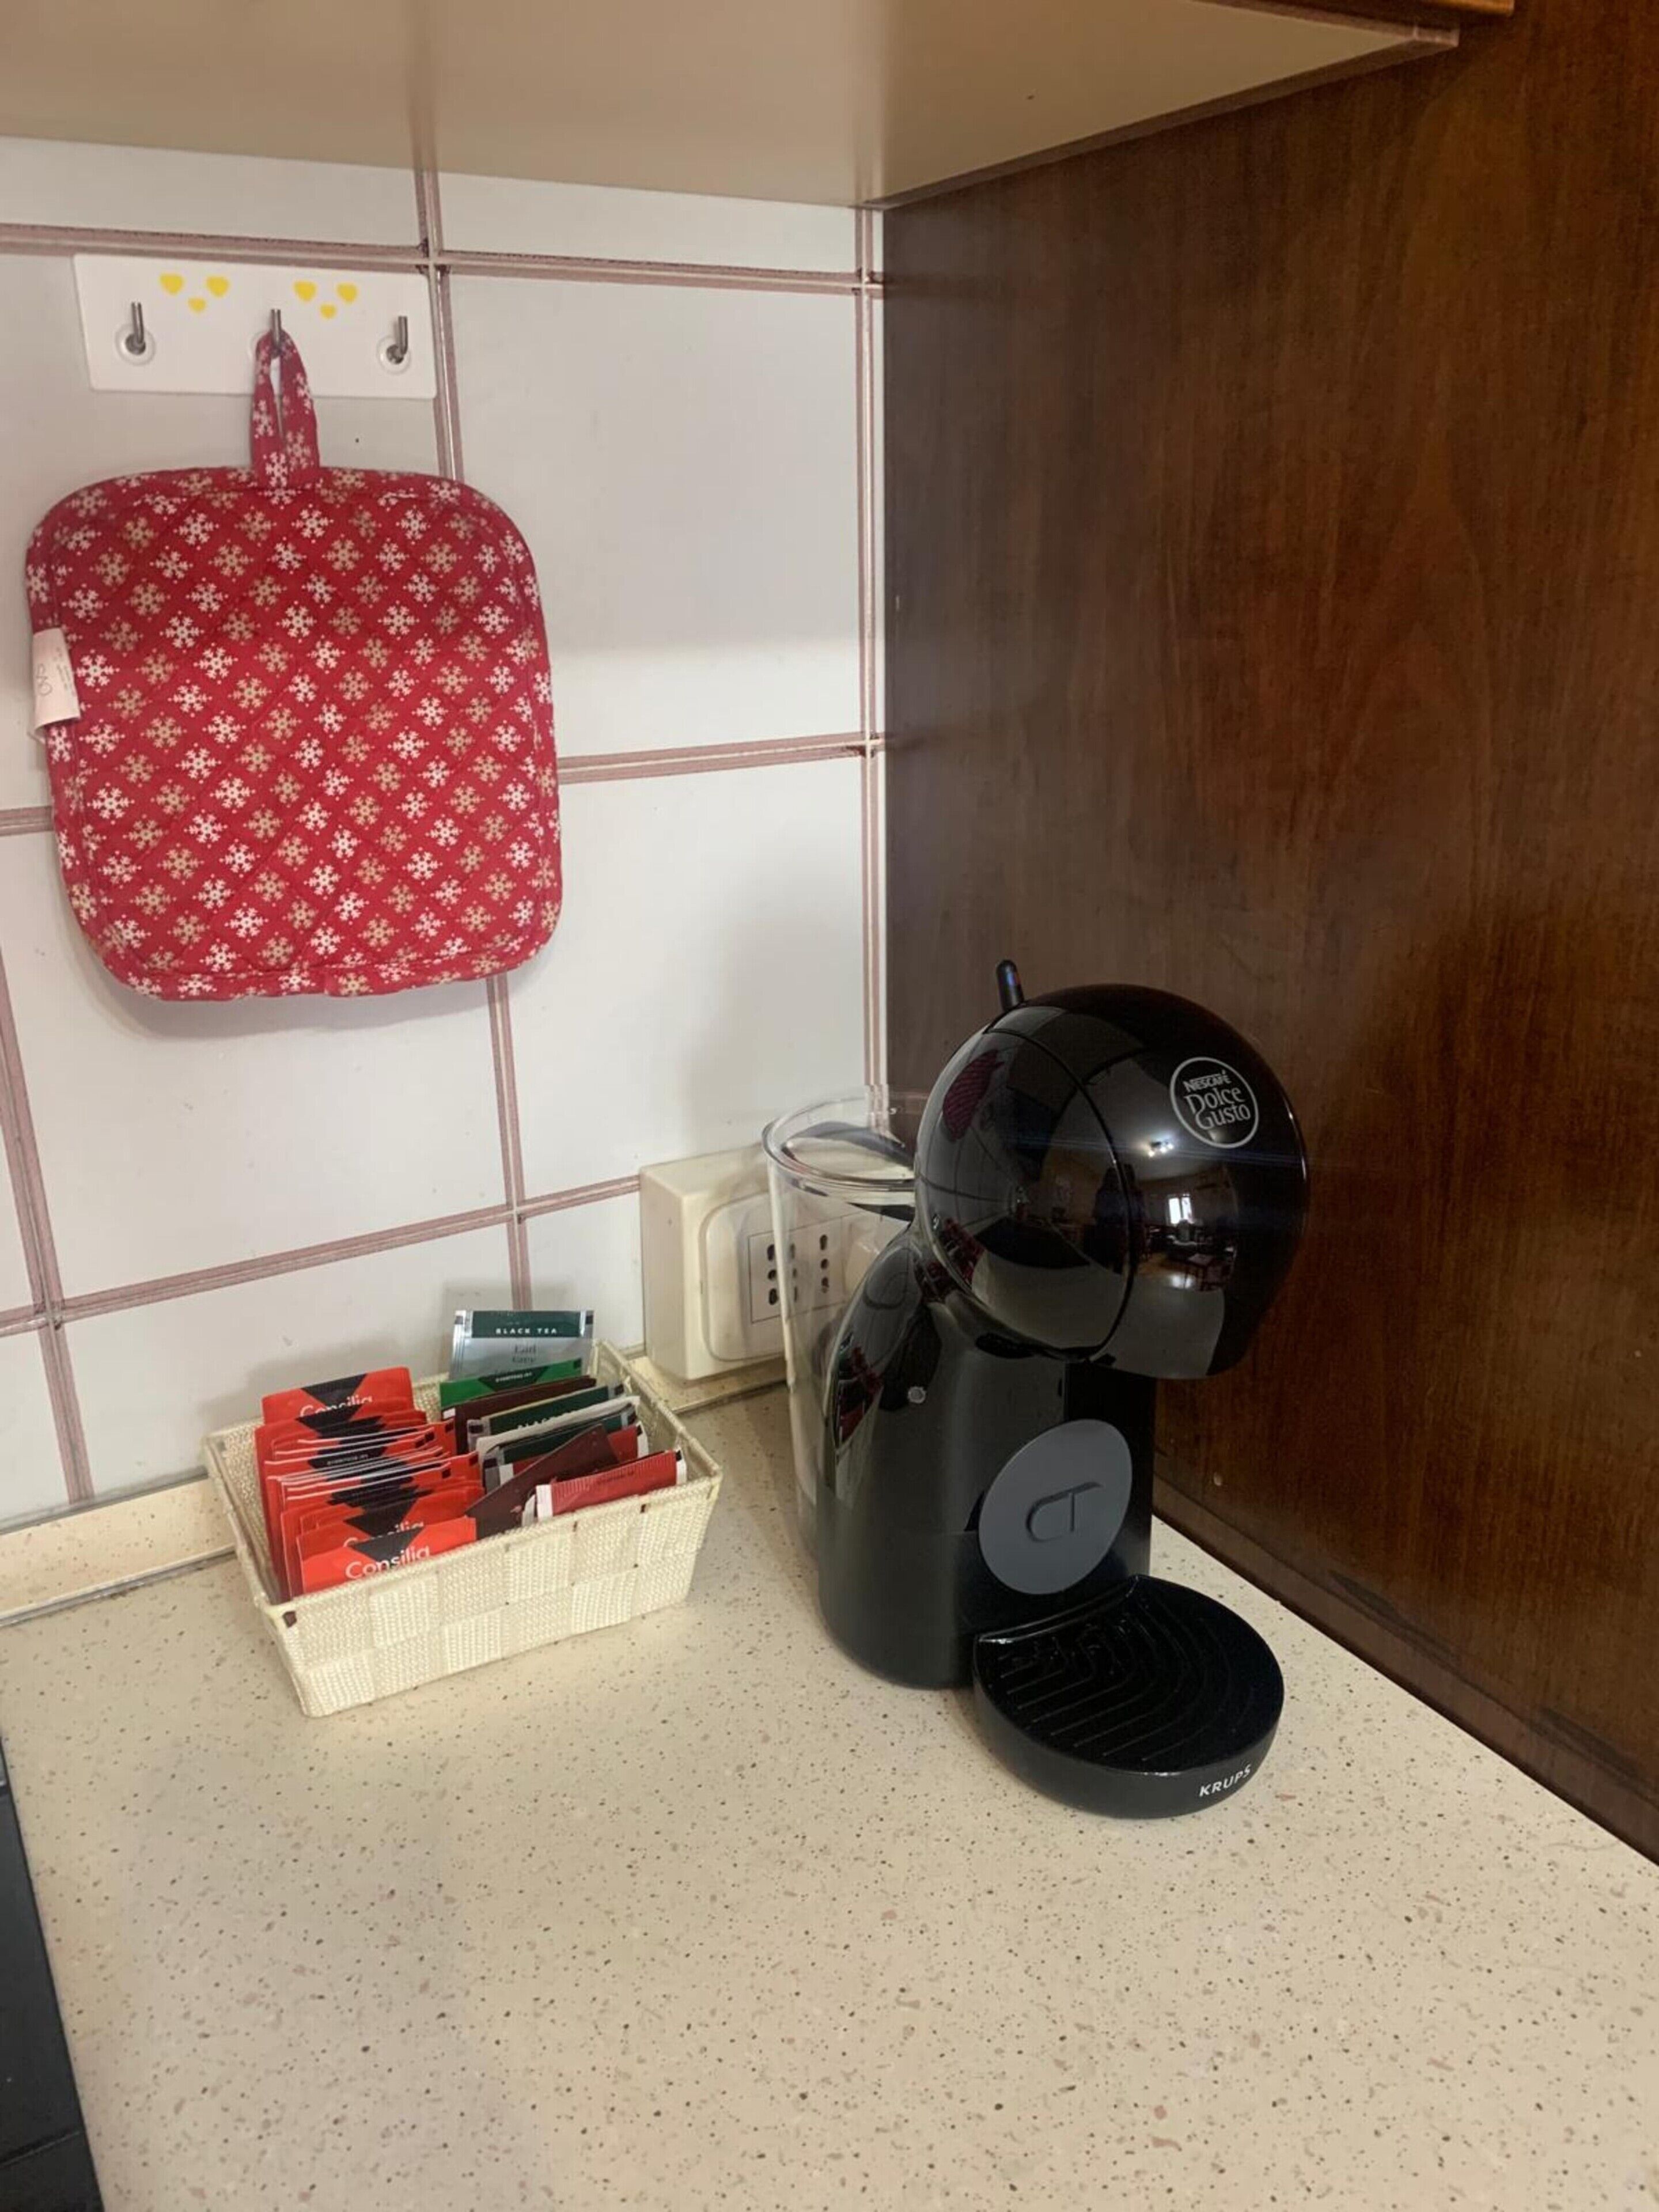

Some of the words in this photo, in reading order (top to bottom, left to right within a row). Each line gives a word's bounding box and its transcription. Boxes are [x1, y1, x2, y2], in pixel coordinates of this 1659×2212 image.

[1184, 1087, 1245, 1114] Dolce
[1195, 1104, 1251, 1130] Gusto
[346, 1546, 430, 1579] Consilia
[1199, 1763, 1252, 1797] KRUPS
